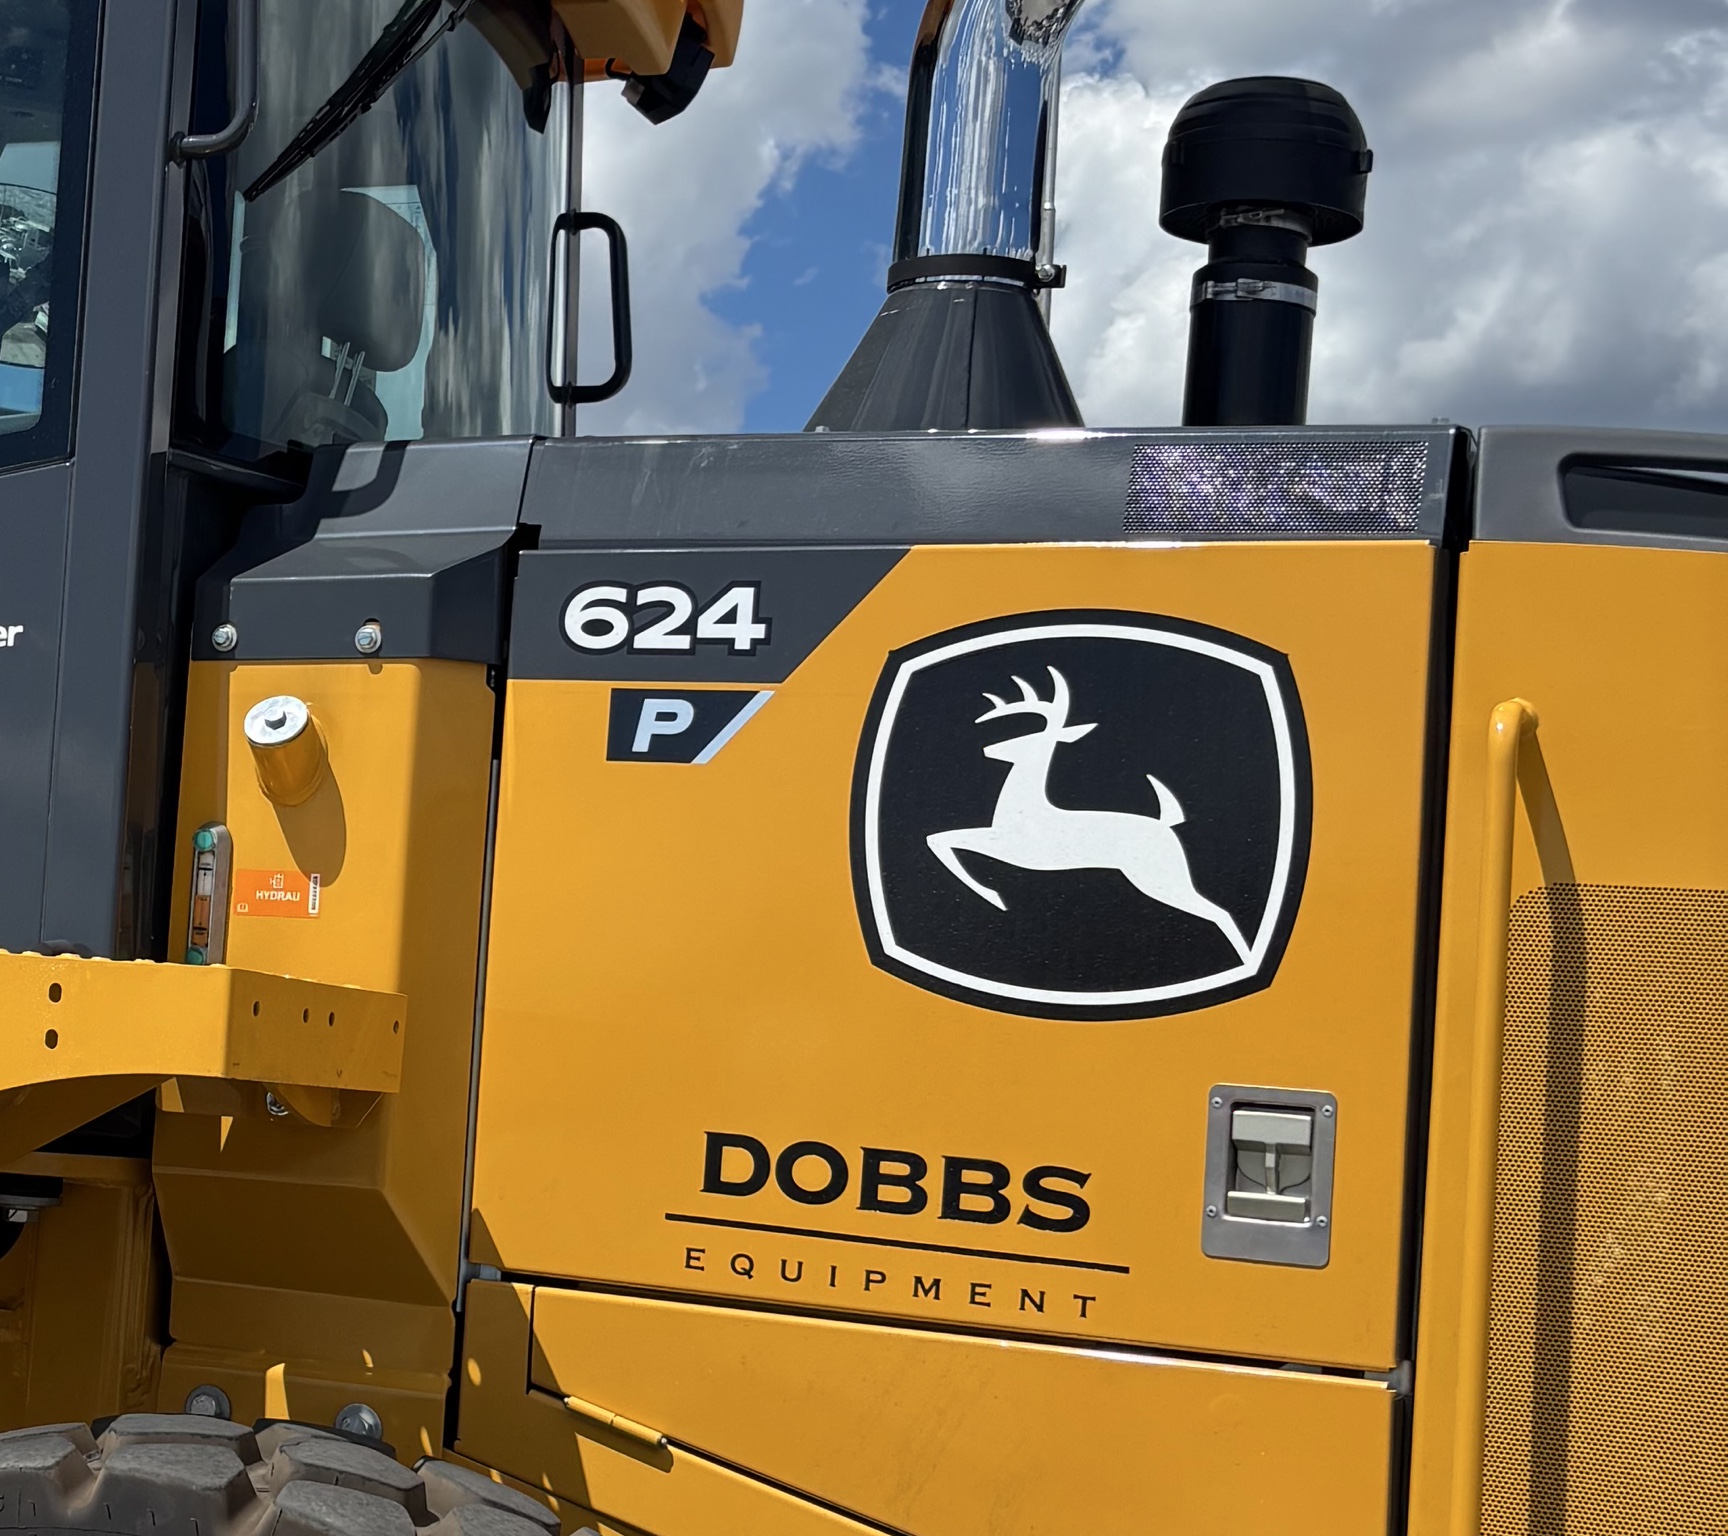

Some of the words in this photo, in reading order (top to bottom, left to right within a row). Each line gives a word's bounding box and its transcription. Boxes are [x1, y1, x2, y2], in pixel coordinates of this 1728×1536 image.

[563, 584, 768, 651] 624
[631, 698, 695, 753] P
[698, 1130, 1093, 1233] DOBBS
[683, 1246, 1098, 1319] EQUIPMENT
